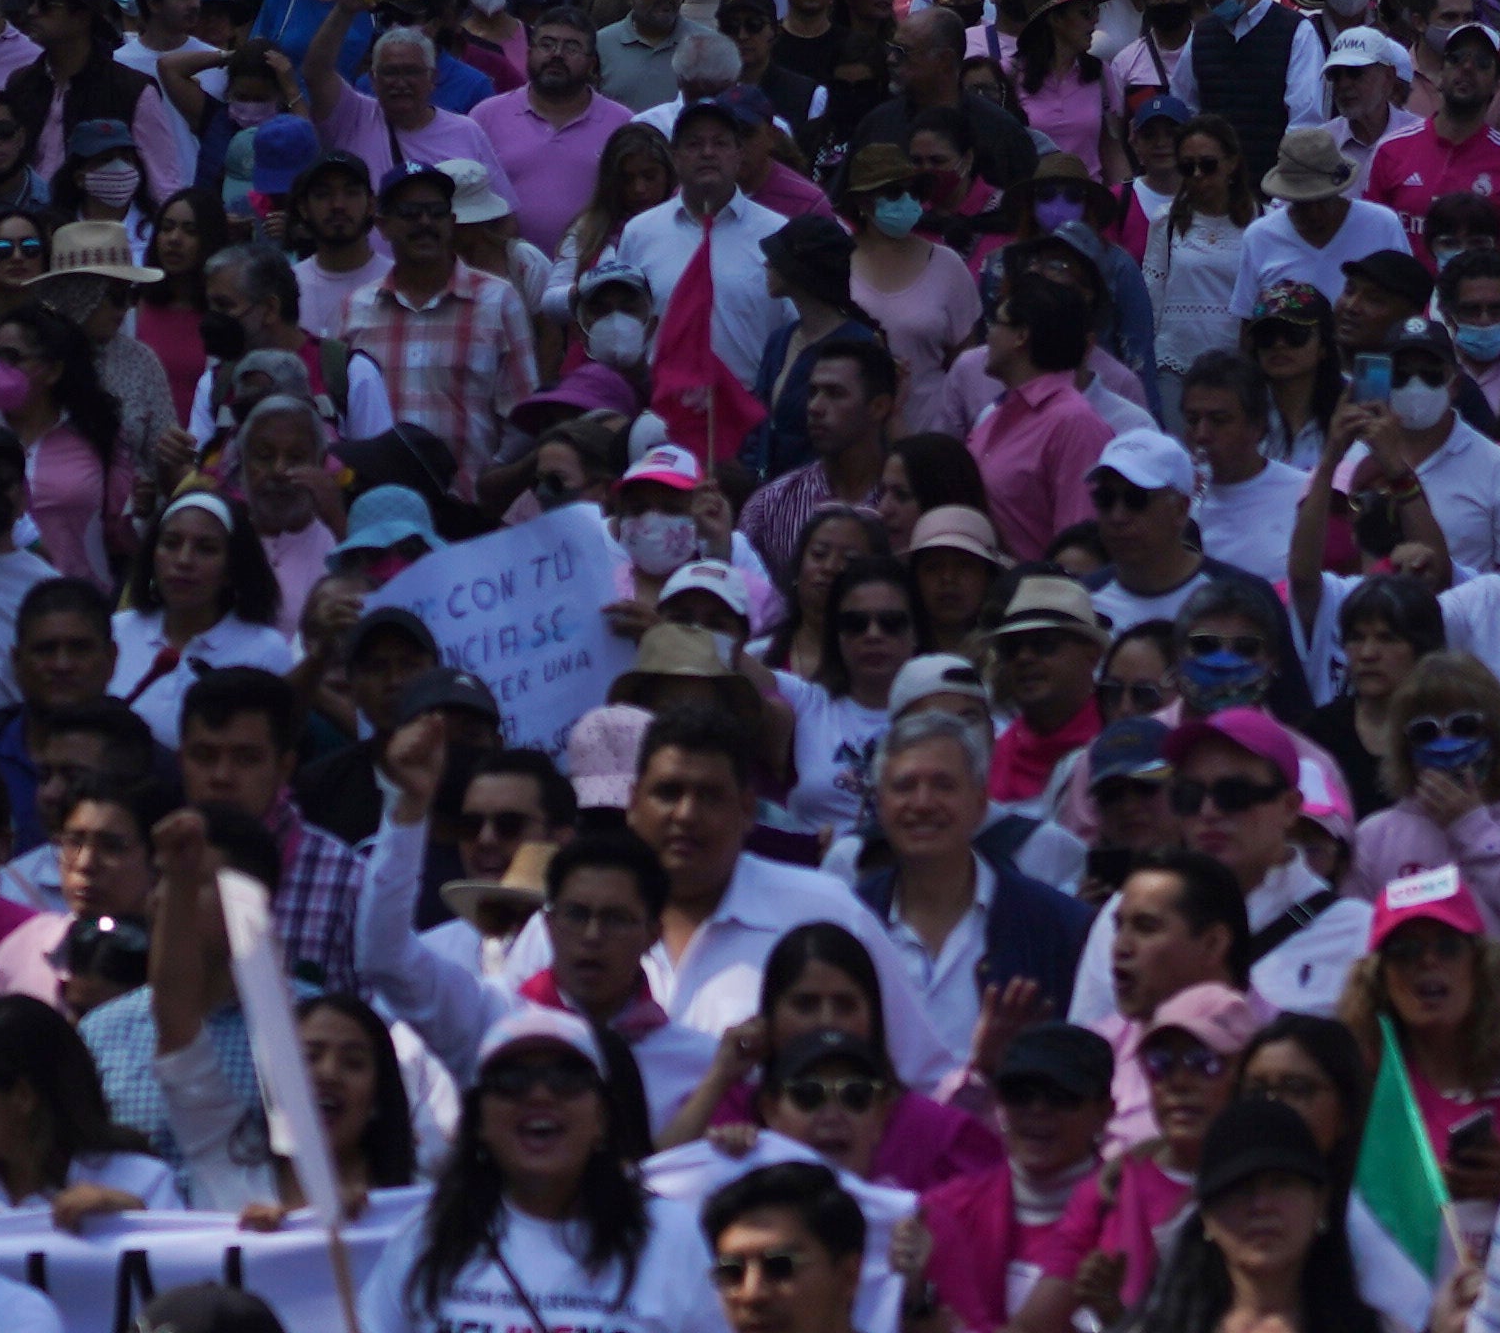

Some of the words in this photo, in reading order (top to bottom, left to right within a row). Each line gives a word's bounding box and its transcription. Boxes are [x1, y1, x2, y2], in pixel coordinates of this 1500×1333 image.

[447, 568, 516, 620] CON
[437, 624, 519, 671] NCIA
[531, 605, 567, 649] SE
[543, 649, 592, 684] UNA
